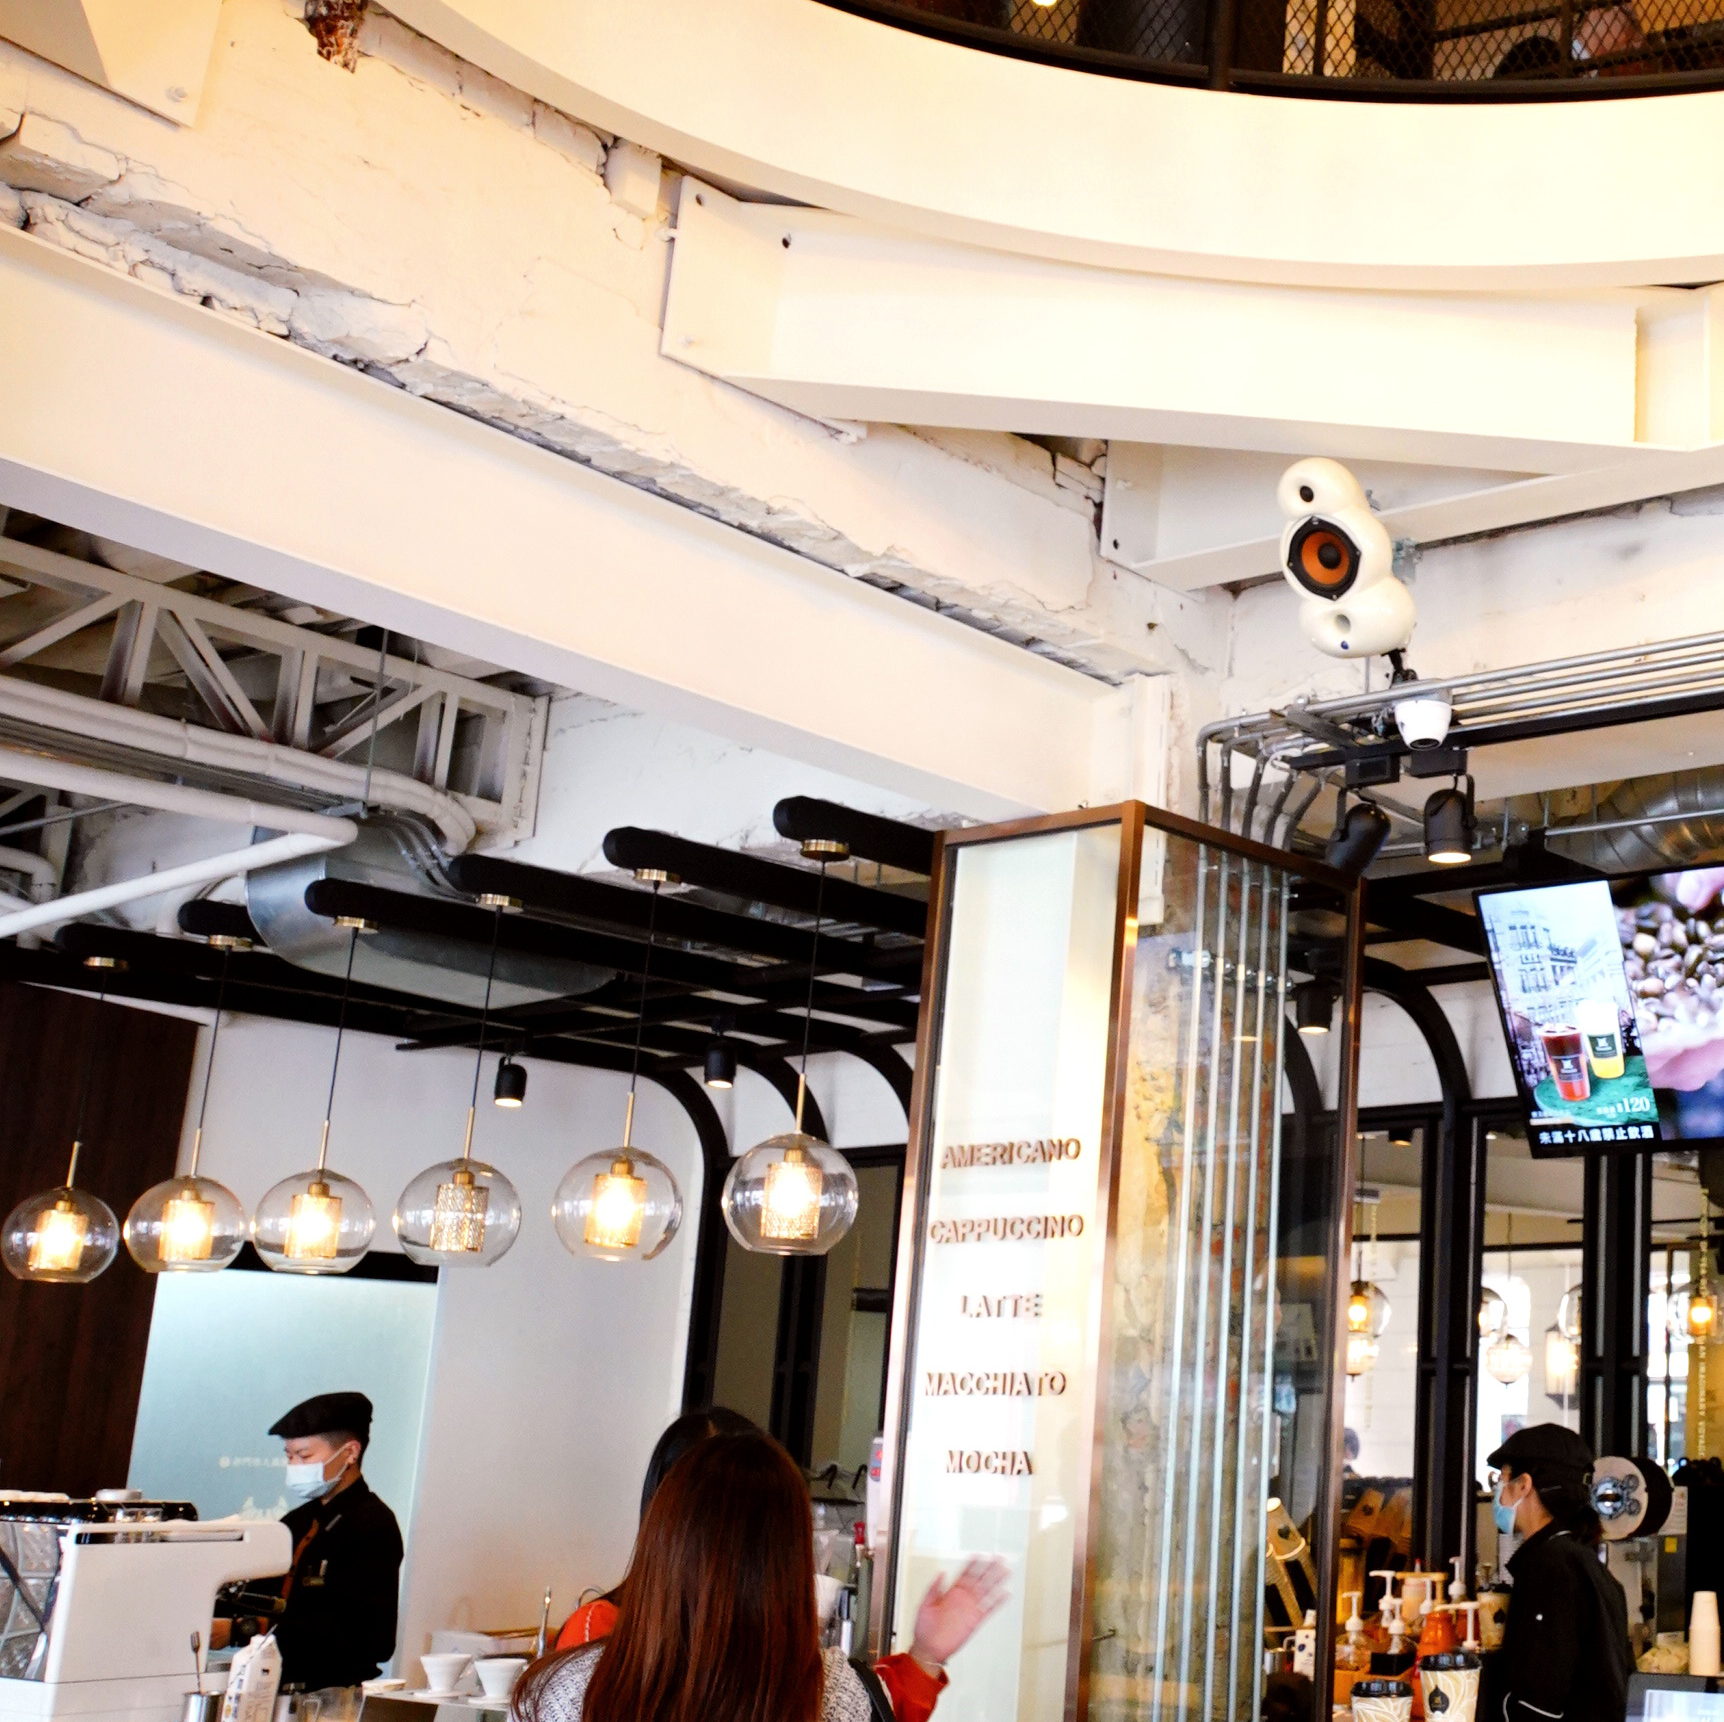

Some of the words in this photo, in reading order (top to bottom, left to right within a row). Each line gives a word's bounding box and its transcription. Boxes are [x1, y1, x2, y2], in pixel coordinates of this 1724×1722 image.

[941, 1138, 1081, 1169] AMERICANO
[929, 1214, 1084, 1243] CAPPUCCINO
[960, 1293, 1043, 1318] LATTE
[925, 1371, 1066, 1396] MACCHIATO
[946, 1450, 1033, 1475] MOCHA
